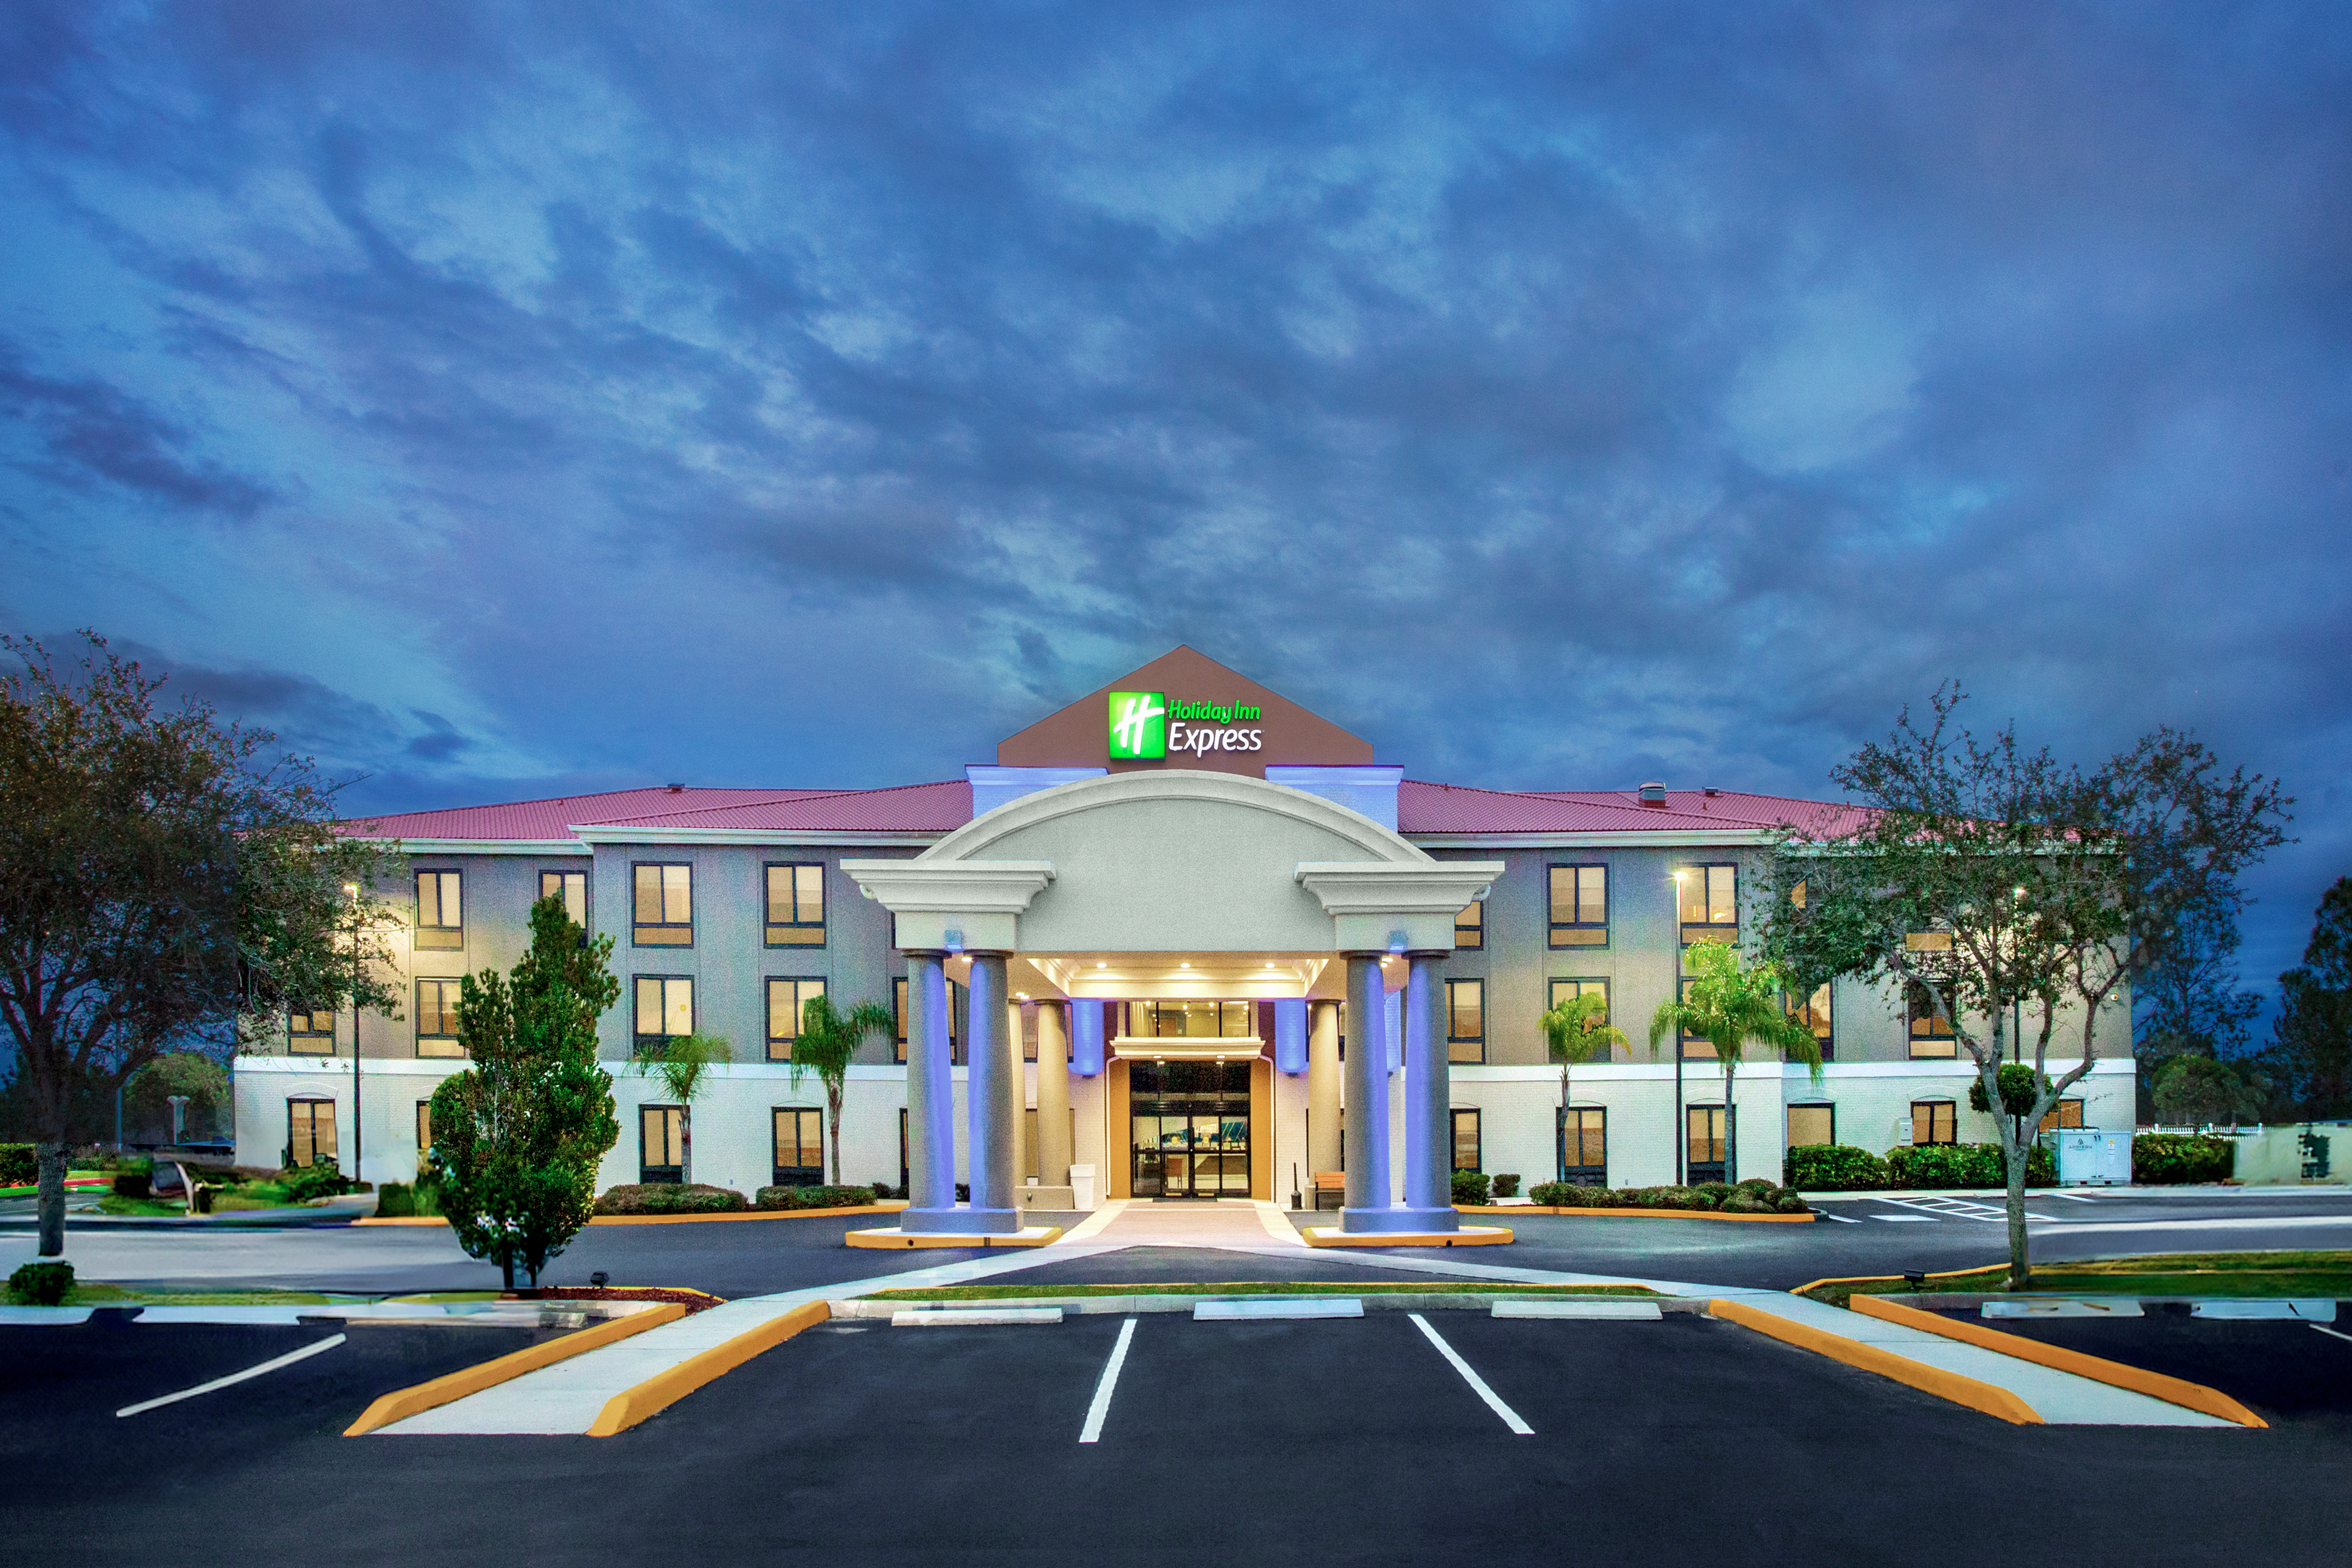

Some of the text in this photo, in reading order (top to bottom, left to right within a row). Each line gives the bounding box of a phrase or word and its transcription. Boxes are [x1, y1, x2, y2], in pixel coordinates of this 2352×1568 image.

[1167, 699, 1261, 724] Holiday Inn
[1169, 722, 1261, 758] Express
